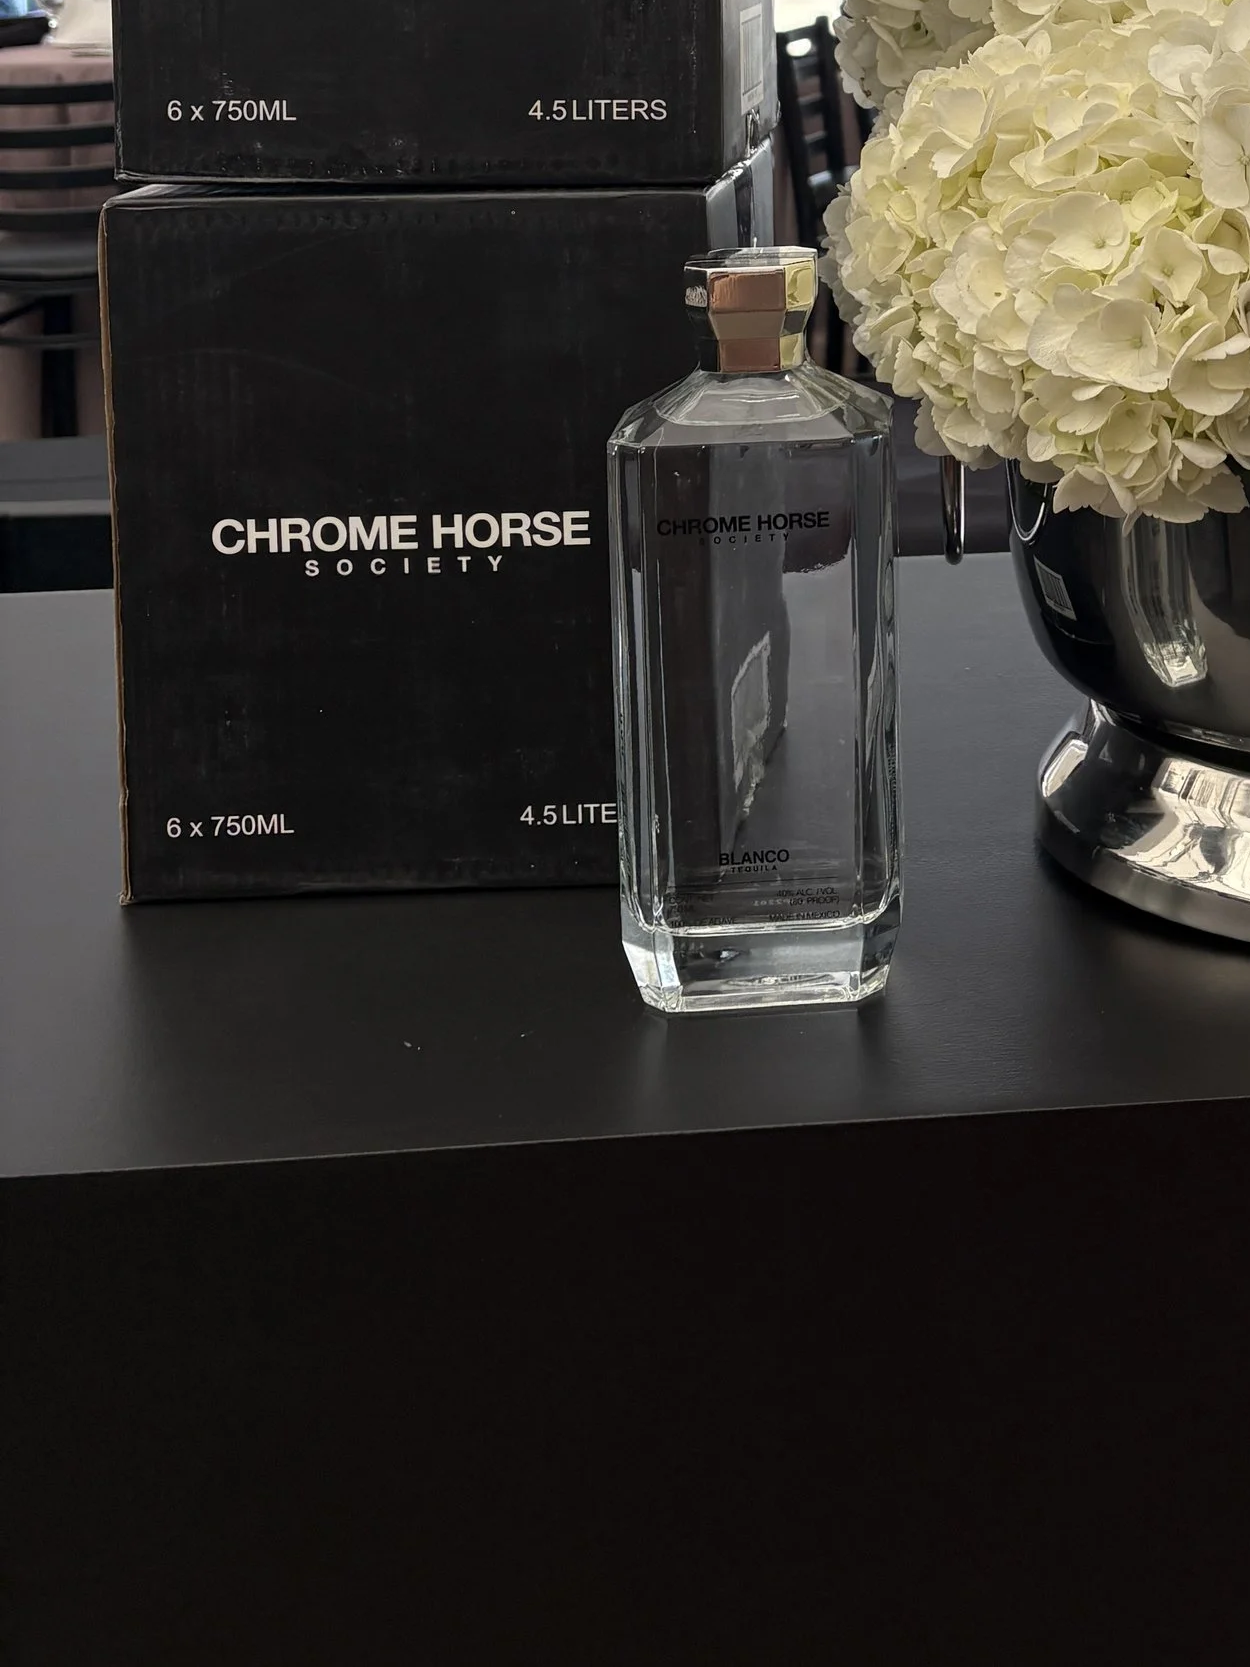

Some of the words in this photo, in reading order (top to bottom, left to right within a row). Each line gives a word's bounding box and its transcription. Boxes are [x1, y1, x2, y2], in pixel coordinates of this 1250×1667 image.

[166, 99, 182, 122] 6
[190, 105, 204, 121] x
[211, 99, 297, 122] 750ML
[528, 99, 567, 121] 4.5
[572, 99, 668, 122] LITERS
[211, 514, 419, 555] CHROME
[432, 510, 591, 549] HORSE
[656, 515, 751, 536] CHROME
[757, 511, 830, 531] HORSE
[699, 533, 790, 546] SOCIETY
[305, 555, 504, 577] SOCIETY
[165, 816, 182, 838] 6
[189, 821, 205, 838] x
[210, 813, 296, 838] 750ML
[519, 804, 558, 827] 4.5
[562, 803, 618, 826] LITE
[718, 848, 790, 866] BLANCO
